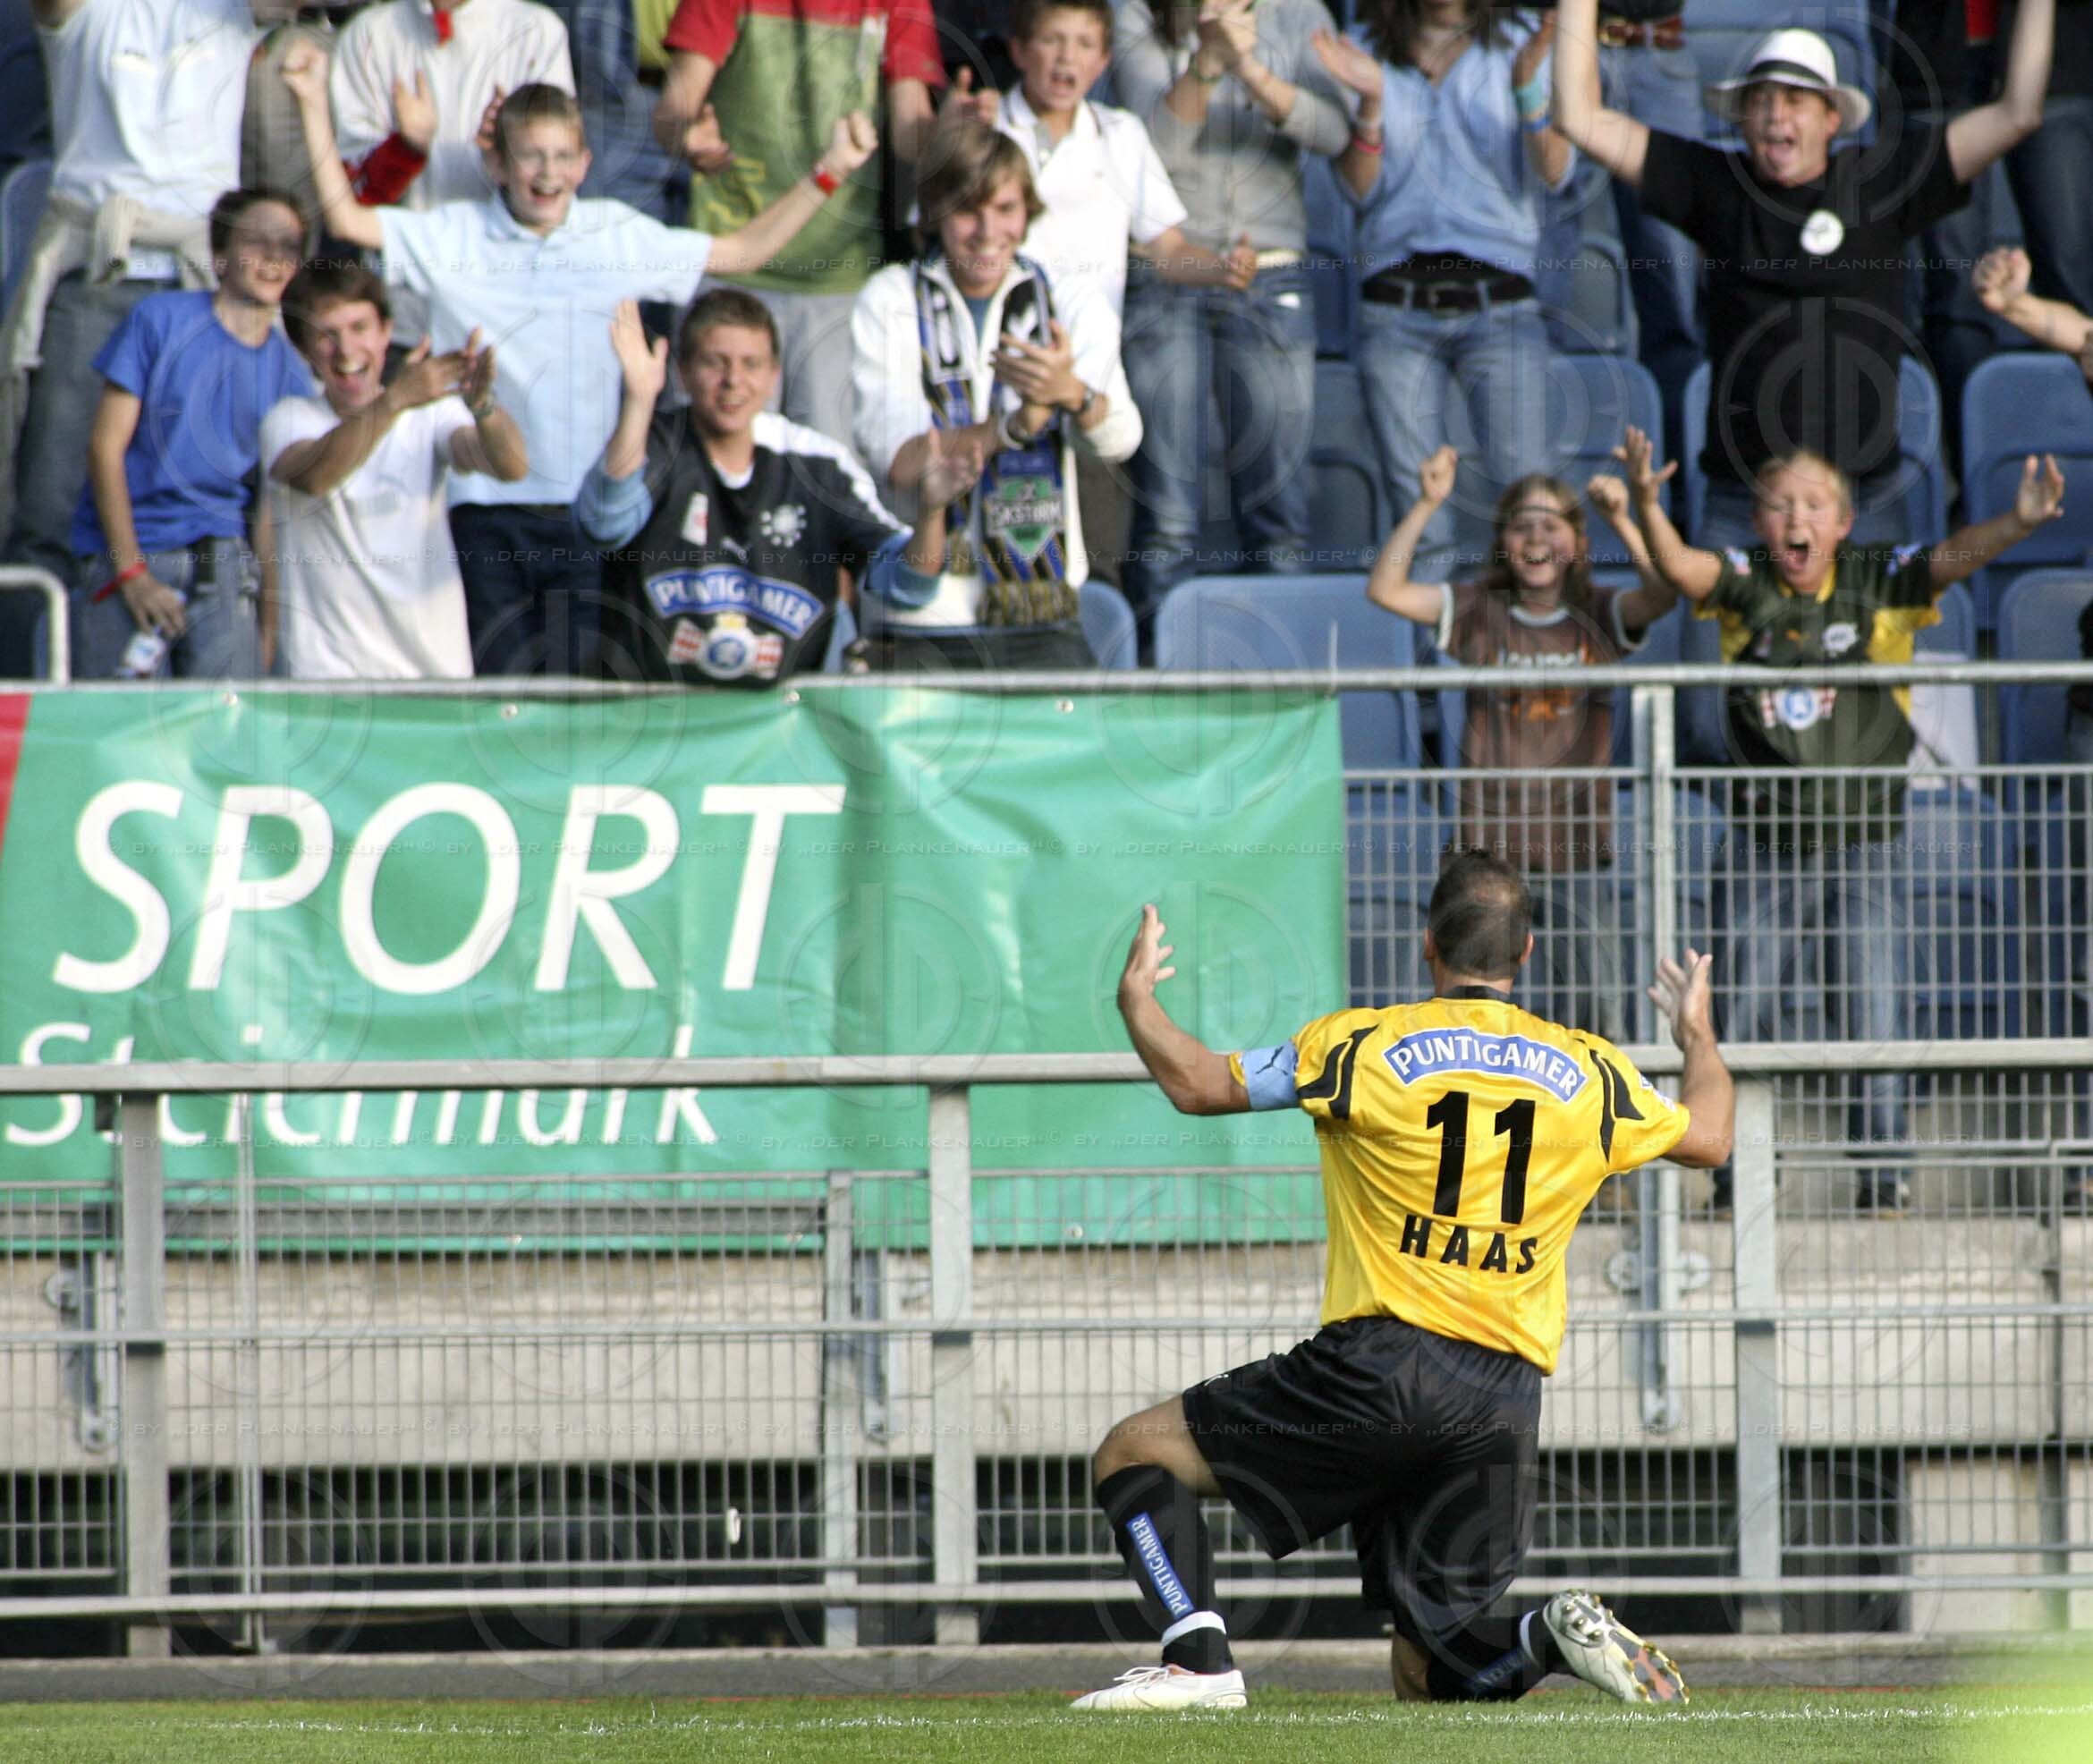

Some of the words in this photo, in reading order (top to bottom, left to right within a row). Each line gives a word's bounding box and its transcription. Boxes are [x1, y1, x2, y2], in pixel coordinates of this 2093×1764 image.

[54, 780, 846, 995] SPORT
[1391, 1035, 1578, 1097] PUNTIGAMER
[1427, 1090, 1536, 1225] 11
[1400, 1214, 1538, 1274] HAAS
[1131, 1516, 1189, 1616] PUNTIGAMER
